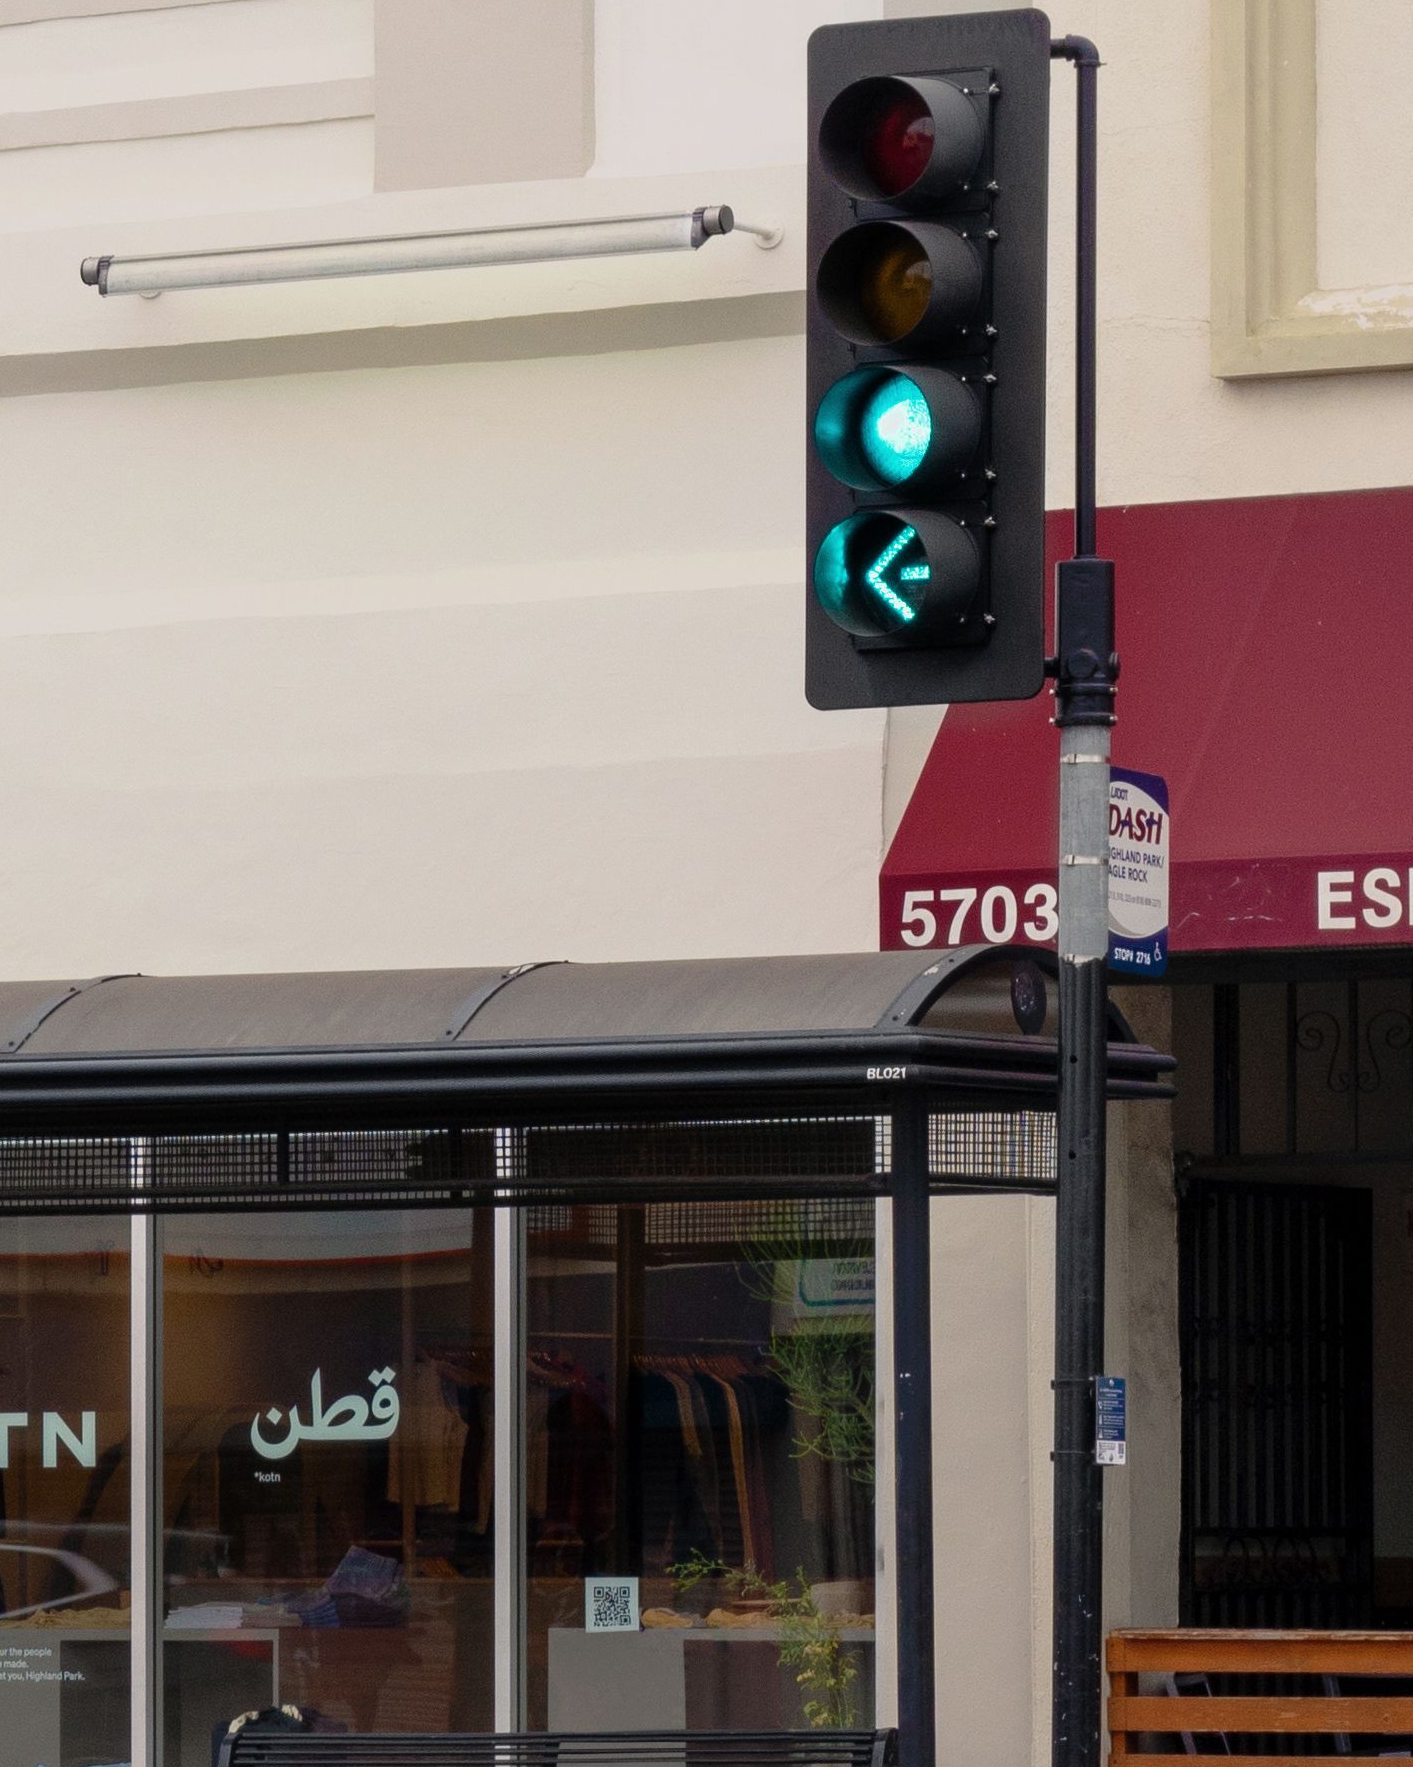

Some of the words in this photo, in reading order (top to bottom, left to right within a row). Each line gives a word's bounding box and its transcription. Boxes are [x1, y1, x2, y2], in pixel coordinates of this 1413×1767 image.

[1109, 803, 1163, 845] DASH
[1108, 864, 1126, 879] AGLE
[1128, 867, 1148, 883] ROCK
[1318, 867, 1413, 930] ES
[900, 884, 1059, 947] 5703
[1136, 951, 1152, 965] 2716
[250, 1366, 400, 1460] قطن
[9, 1646, 23, 1657] the
[24, 1647, 52, 1659] people
[3, 1659, 29, 1669] made.
[7, 1672, 25, 1683] you,
[25, 1670, 62, 1683] Highland
[63, 1671, 86, 1681] Park.
